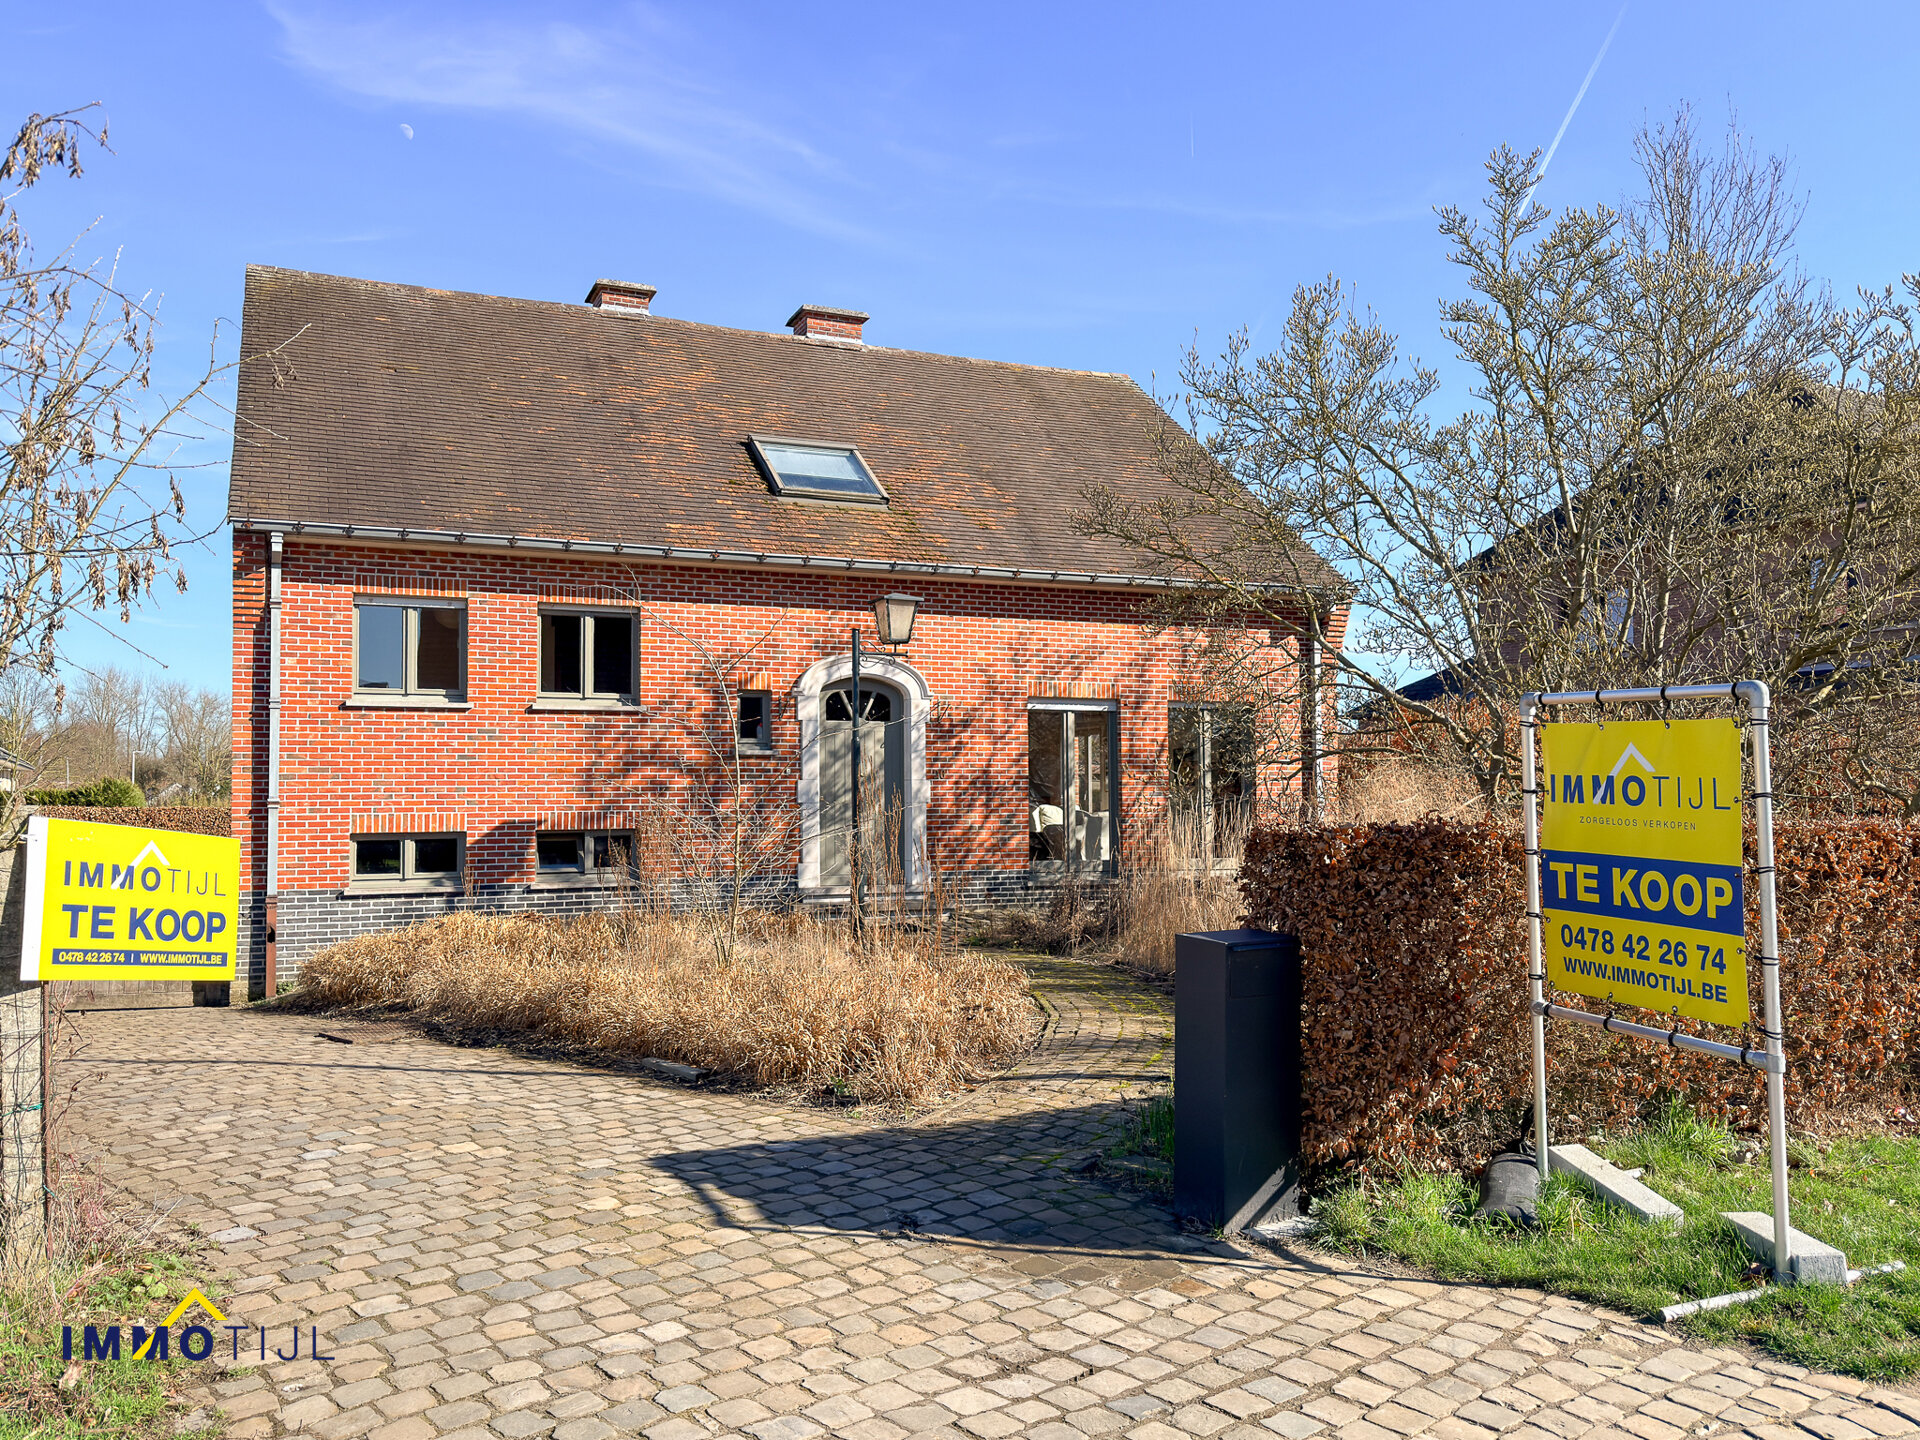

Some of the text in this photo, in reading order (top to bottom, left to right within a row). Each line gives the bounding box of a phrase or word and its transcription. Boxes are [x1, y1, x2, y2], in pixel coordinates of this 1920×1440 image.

[1550, 774, 1731, 810] IMMOTIJL
[1579, 816, 1696, 830] ZORGELOOS VERKOPEN
[64, 861, 226, 896] IMMOTIJL
[1550, 862, 1733, 919] TE KOOP
[62, 904, 226, 942] TE KOOP
[59, 952, 83, 962] 0478
[85, 952, 98, 962] 42
[99, 952, 112, 963] 26
[113, 953, 125, 963] 74
[140, 953, 222, 964] WWW.IMMOTIJL.BE
[1561, 924, 1727, 974] 0478 42 26 74
[1563, 956, 1728, 1003] WWW.IMMOTIJL.BE
